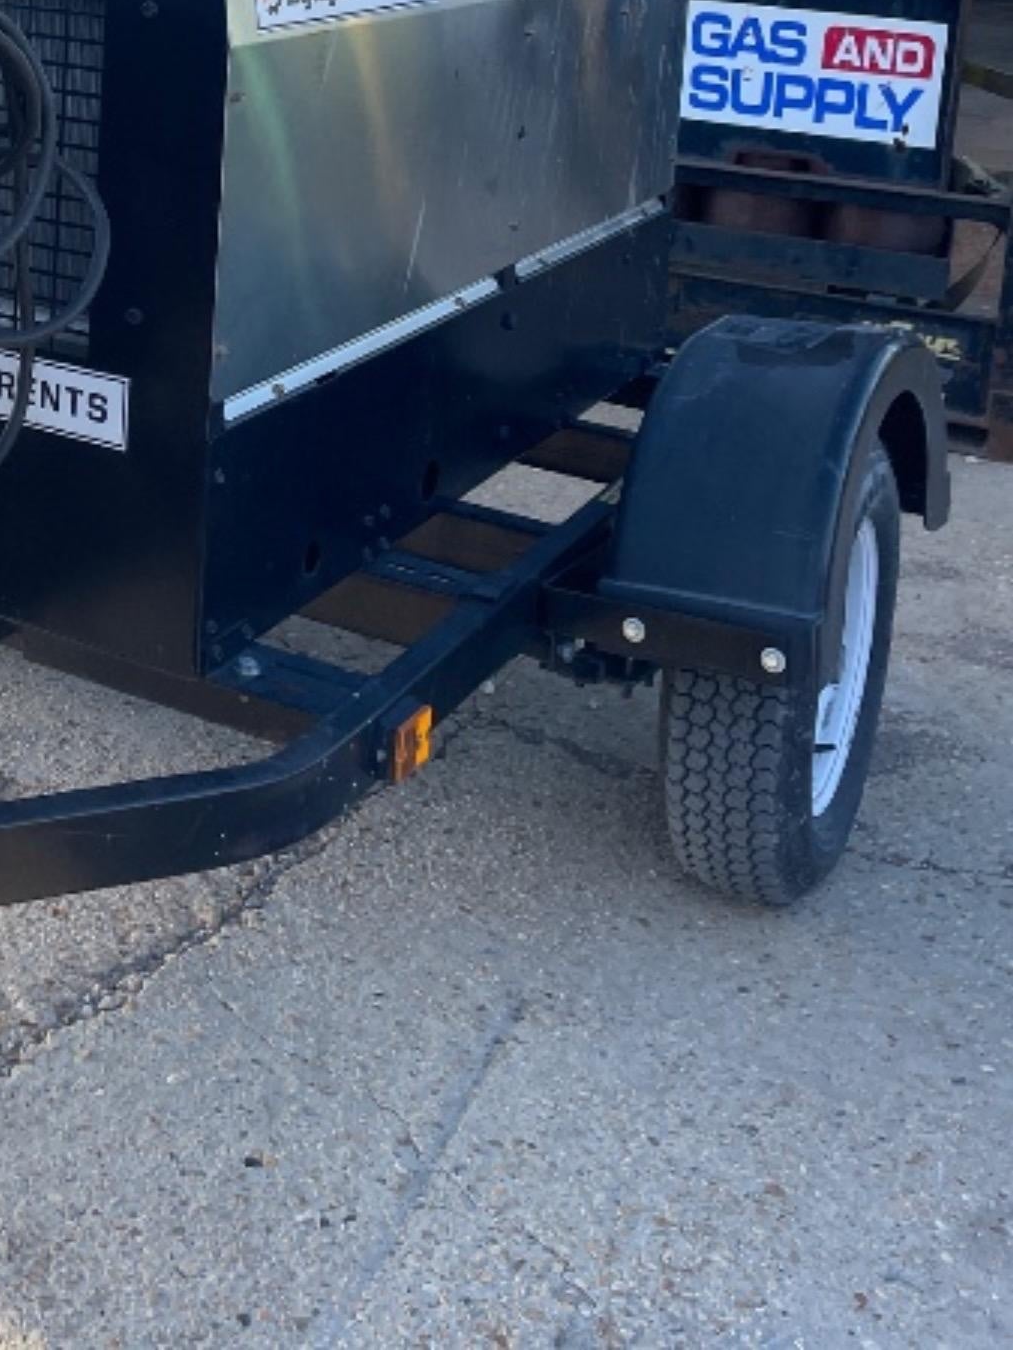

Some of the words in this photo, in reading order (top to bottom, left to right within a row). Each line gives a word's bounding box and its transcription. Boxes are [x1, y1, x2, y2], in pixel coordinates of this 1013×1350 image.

[692, 11, 808, 66] GAS
[832, 35, 925, 74] AND
[688, 63, 926, 133] SUPPLY
